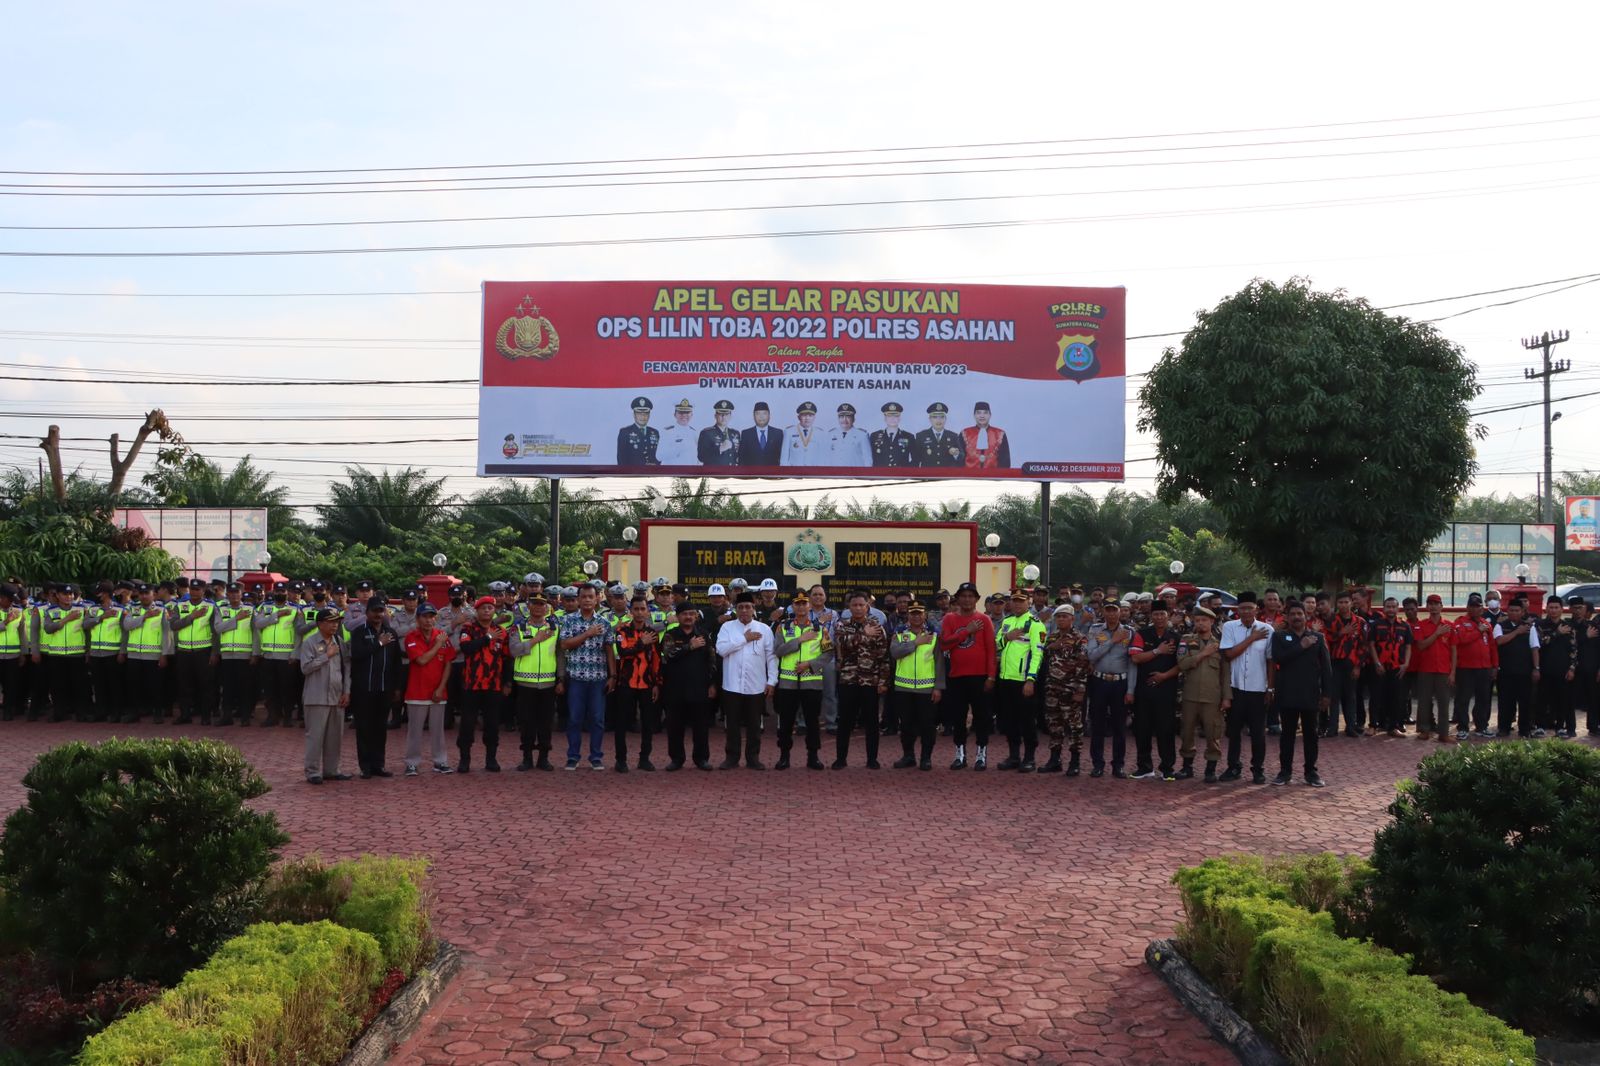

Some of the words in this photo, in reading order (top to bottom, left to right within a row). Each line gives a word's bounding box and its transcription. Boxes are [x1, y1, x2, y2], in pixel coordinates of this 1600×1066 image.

[653, 288, 723, 311] APEL
[731, 288, 822, 312] GELAR
[830, 289, 959, 314] PASUKAN
[1051, 302, 1101, 314] POLRES
[597, 317, 643, 338] OPS
[648, 317, 703, 338] LILIN
[709, 317, 766, 338] TOBA
[771, 317, 827, 338] 2022
[833, 318, 920, 339] POLRES
[925, 319, 1014, 341] ASAHAN
[767, 345, 801, 356] Dalam
[805, 345, 844, 358] Rangka
[643, 361, 735, 373] PENGAMANAN
[739, 361, 779, 373] NATAL
[783, 362, 815, 373] 2022
[819, 362, 846, 374] DAN
[849, 363, 892, 374] TAHUN
[895, 364, 931, 375] BARU
[934, 364, 967, 375] 2023
[699, 378, 713, 388] DI
[717, 378, 774, 389] WILAYAH
[778, 378, 854, 389] KABUPATEN
[857, 379, 911, 390] ASAHAN
[1029, 465, 1060, 473] KISARAN,
[696, 550, 718, 565] TRI
[725, 550, 766, 566] BRATA
[848, 551, 878, 566] CATUR
[880, 551, 929, 567] PRASETYA
